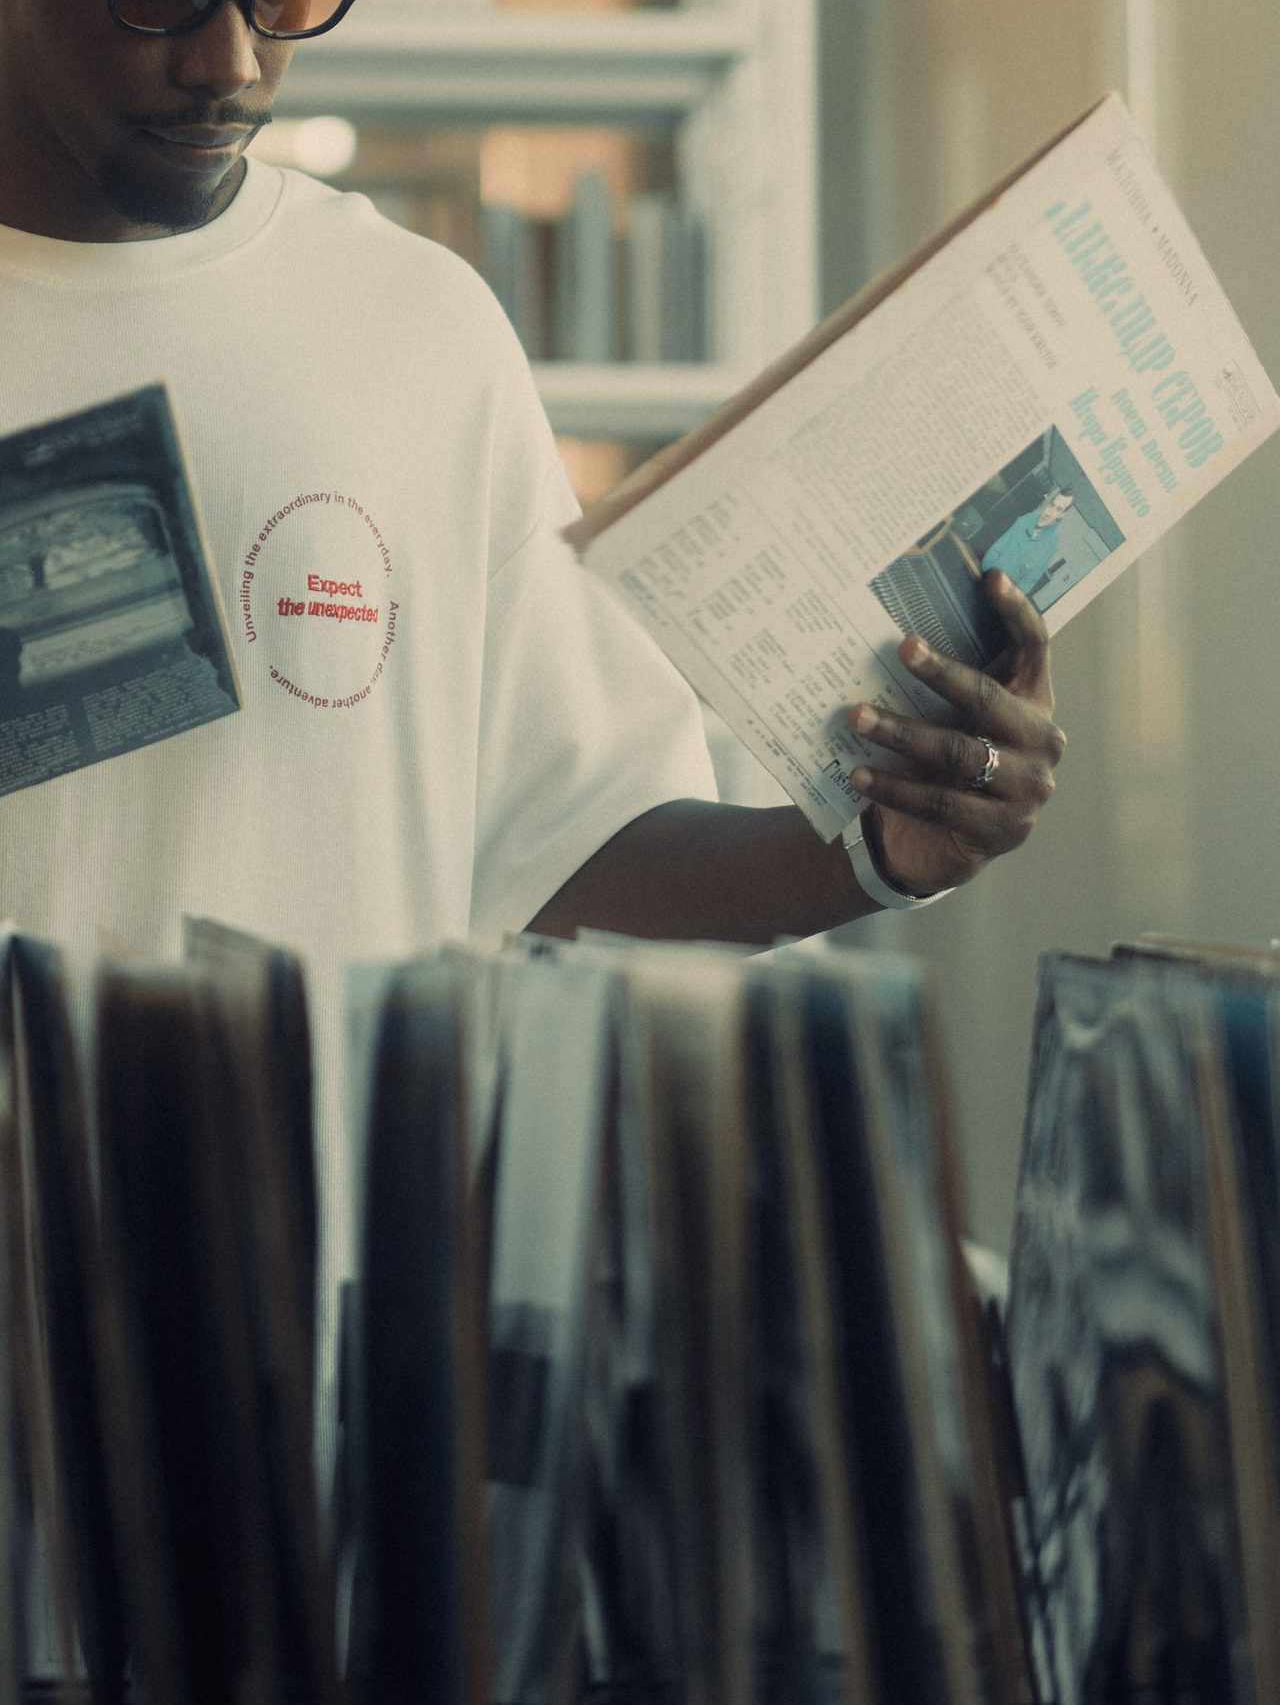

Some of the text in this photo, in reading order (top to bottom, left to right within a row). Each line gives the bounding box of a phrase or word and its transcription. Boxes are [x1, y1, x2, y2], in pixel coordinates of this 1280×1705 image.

[1155, 232, 1198, 307] MADONNA
[1148, 370, 1225, 469] СЕРОВ
[240, 491, 393, 642] Unveiling the extraordinary in the everyday.
[308, 574, 362, 597] Expect
[278, 598, 378, 623] the unexpected
[382, 601, 399, 661] Another
[269, 666, 328, 707] adventure.
[333, 686, 371, 708] another
